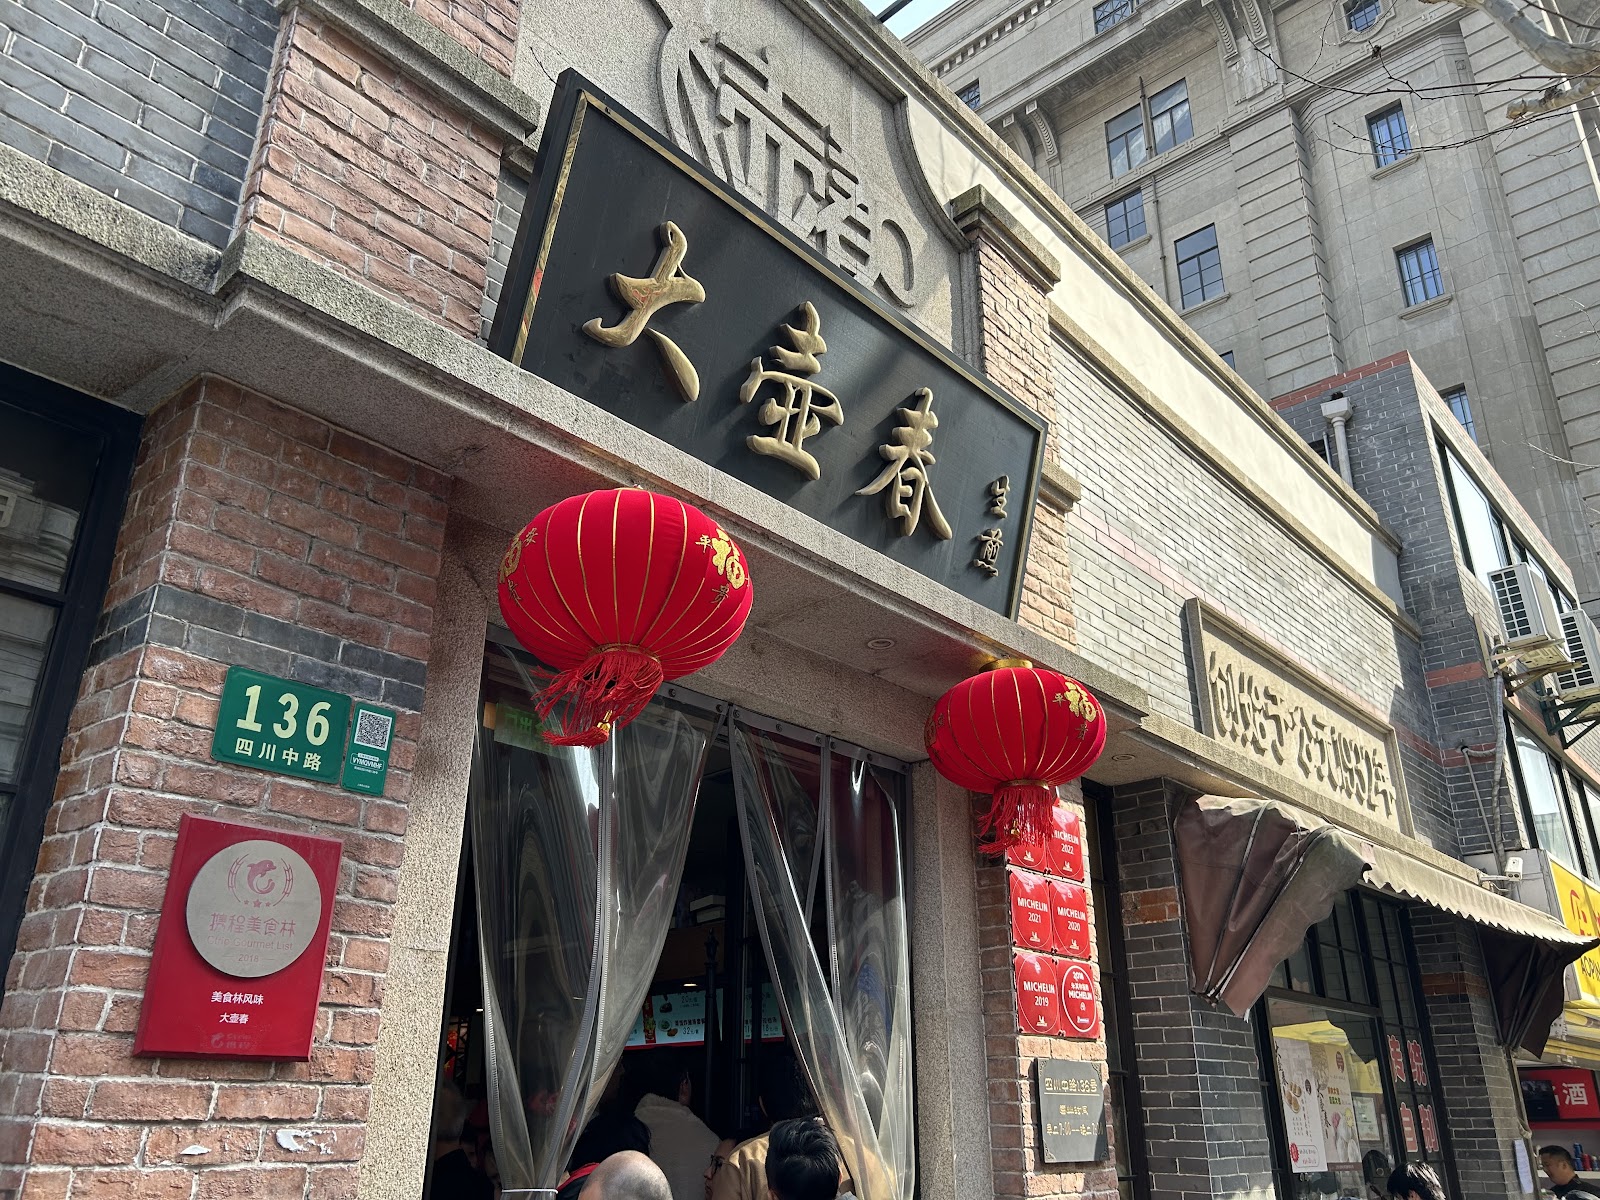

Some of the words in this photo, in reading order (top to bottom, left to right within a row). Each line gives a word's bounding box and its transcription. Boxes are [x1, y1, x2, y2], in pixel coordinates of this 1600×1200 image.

[582, 220, 953, 541] 大壶春
[711, 527, 745, 589] 福
[1064, 681, 1097, 722] 福
[236, 684, 332, 747] 136
[234, 737, 322, 772] 四川中路
[1053, 829, 1079, 845] MICHELIN
[1061, 843, 1074, 855] 2022
[1017, 897, 1048, 912] MICHELIN
[1028, 912, 1042, 923] 2021
[1057, 906, 1086, 921] MICHELIN
[208, 912, 297, 938] 携程美食林
[1067, 921, 1081, 931] 2020
[234, 938, 275, 950] Gourmet
[276, 941, 294, 951] List
[238, 953, 259, 963] 2018
[1023, 981, 1055, 995] MICHELIN
[1068, 989, 1094, 1001] MICHELIN
[211, 990, 264, 1005] 美食林风味
[1034, 995, 1049, 1007] 2019
[219, 1012, 249, 1024] 大壶春
[1044, 1077, 1098, 1093] 四川中路136号
[1400, 1101, 1439, 1153] 自制
